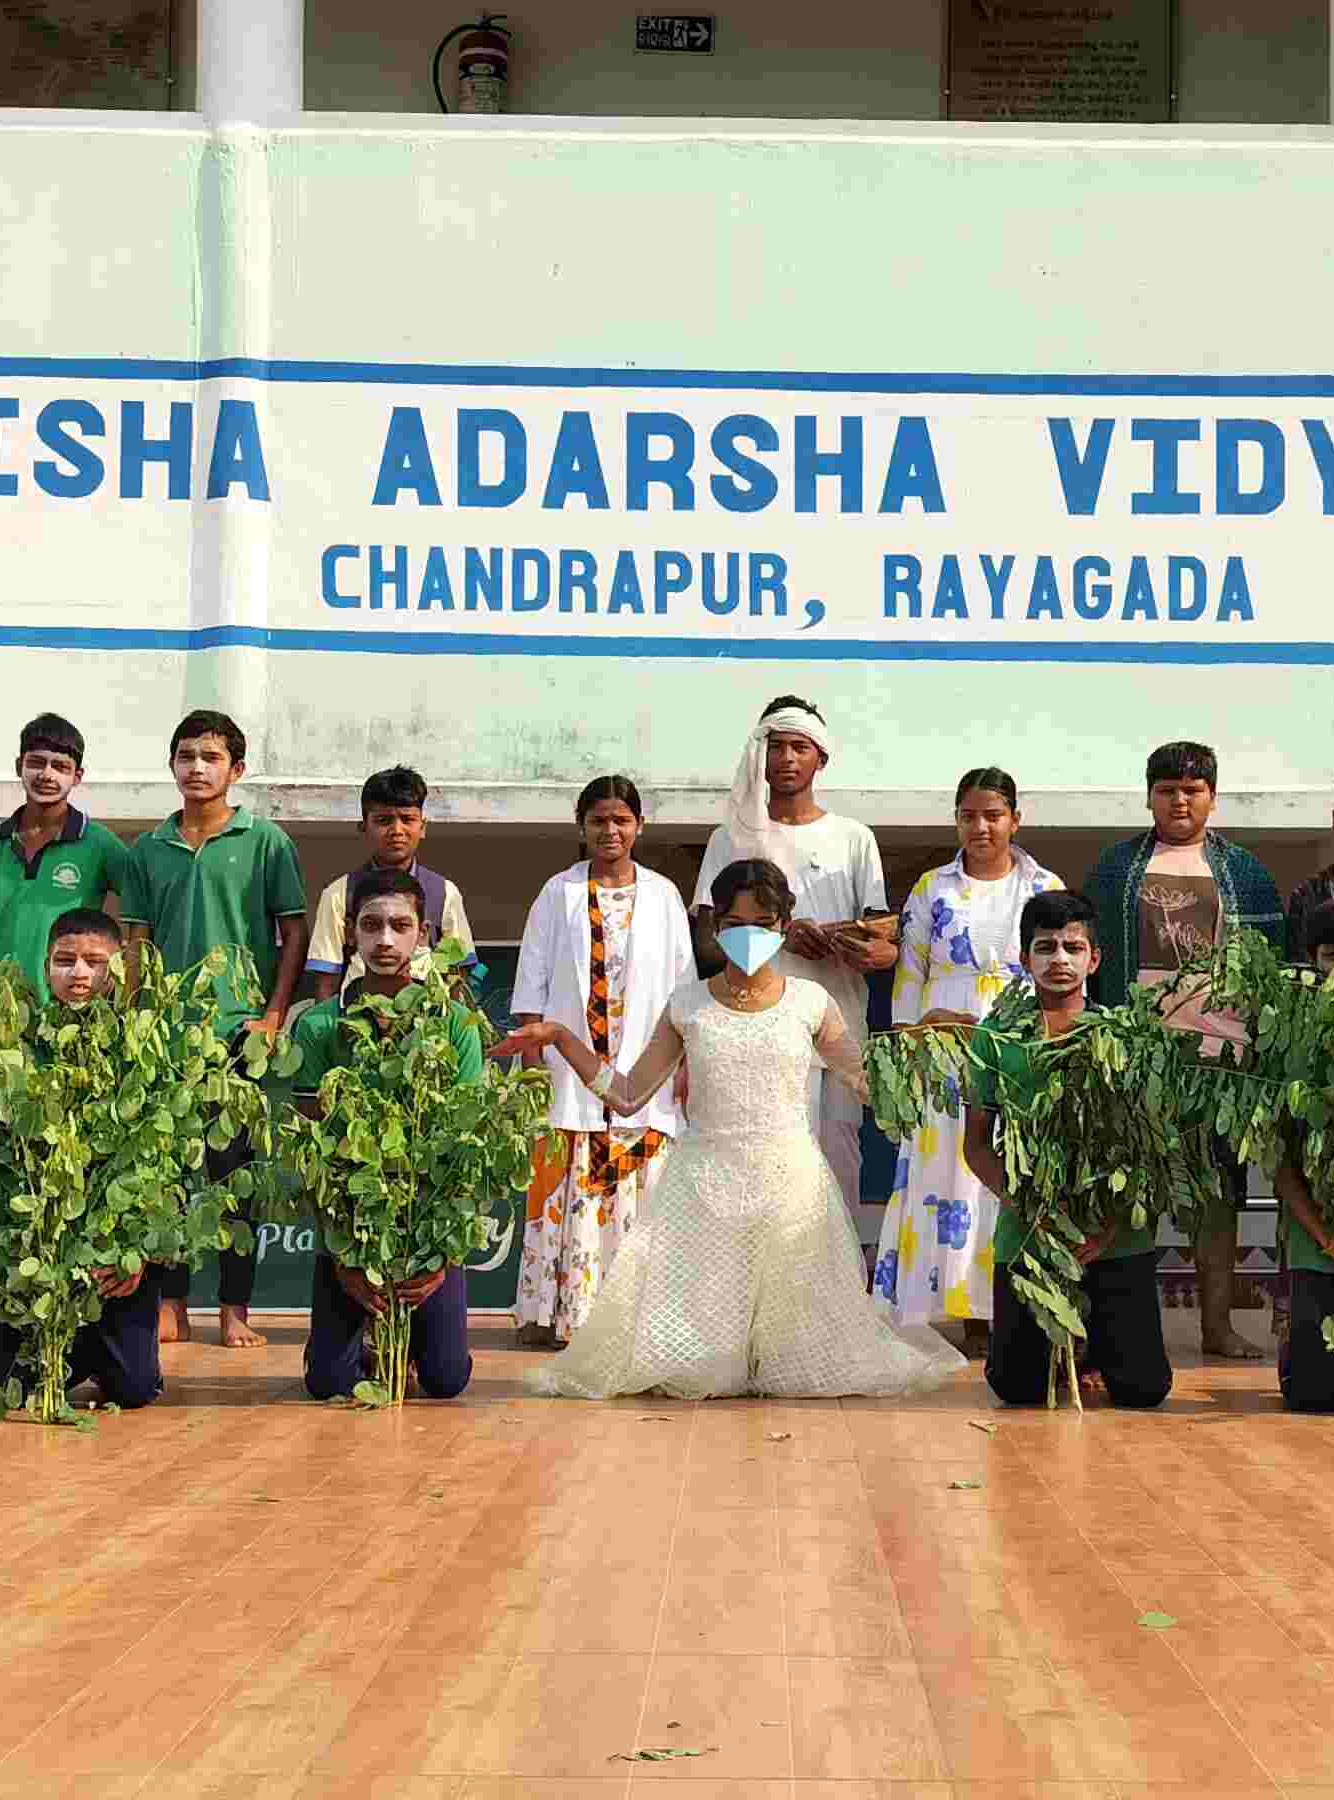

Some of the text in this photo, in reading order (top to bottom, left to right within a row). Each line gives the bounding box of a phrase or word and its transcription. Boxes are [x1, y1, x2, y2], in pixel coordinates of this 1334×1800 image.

[638, 16, 672, 31] EXIT
[372, 406, 946, 513] ADARSHA
[321, 544, 826, 630] CHANDRAPUR,
[883, 553, 1254, 621] RAYAGADA
